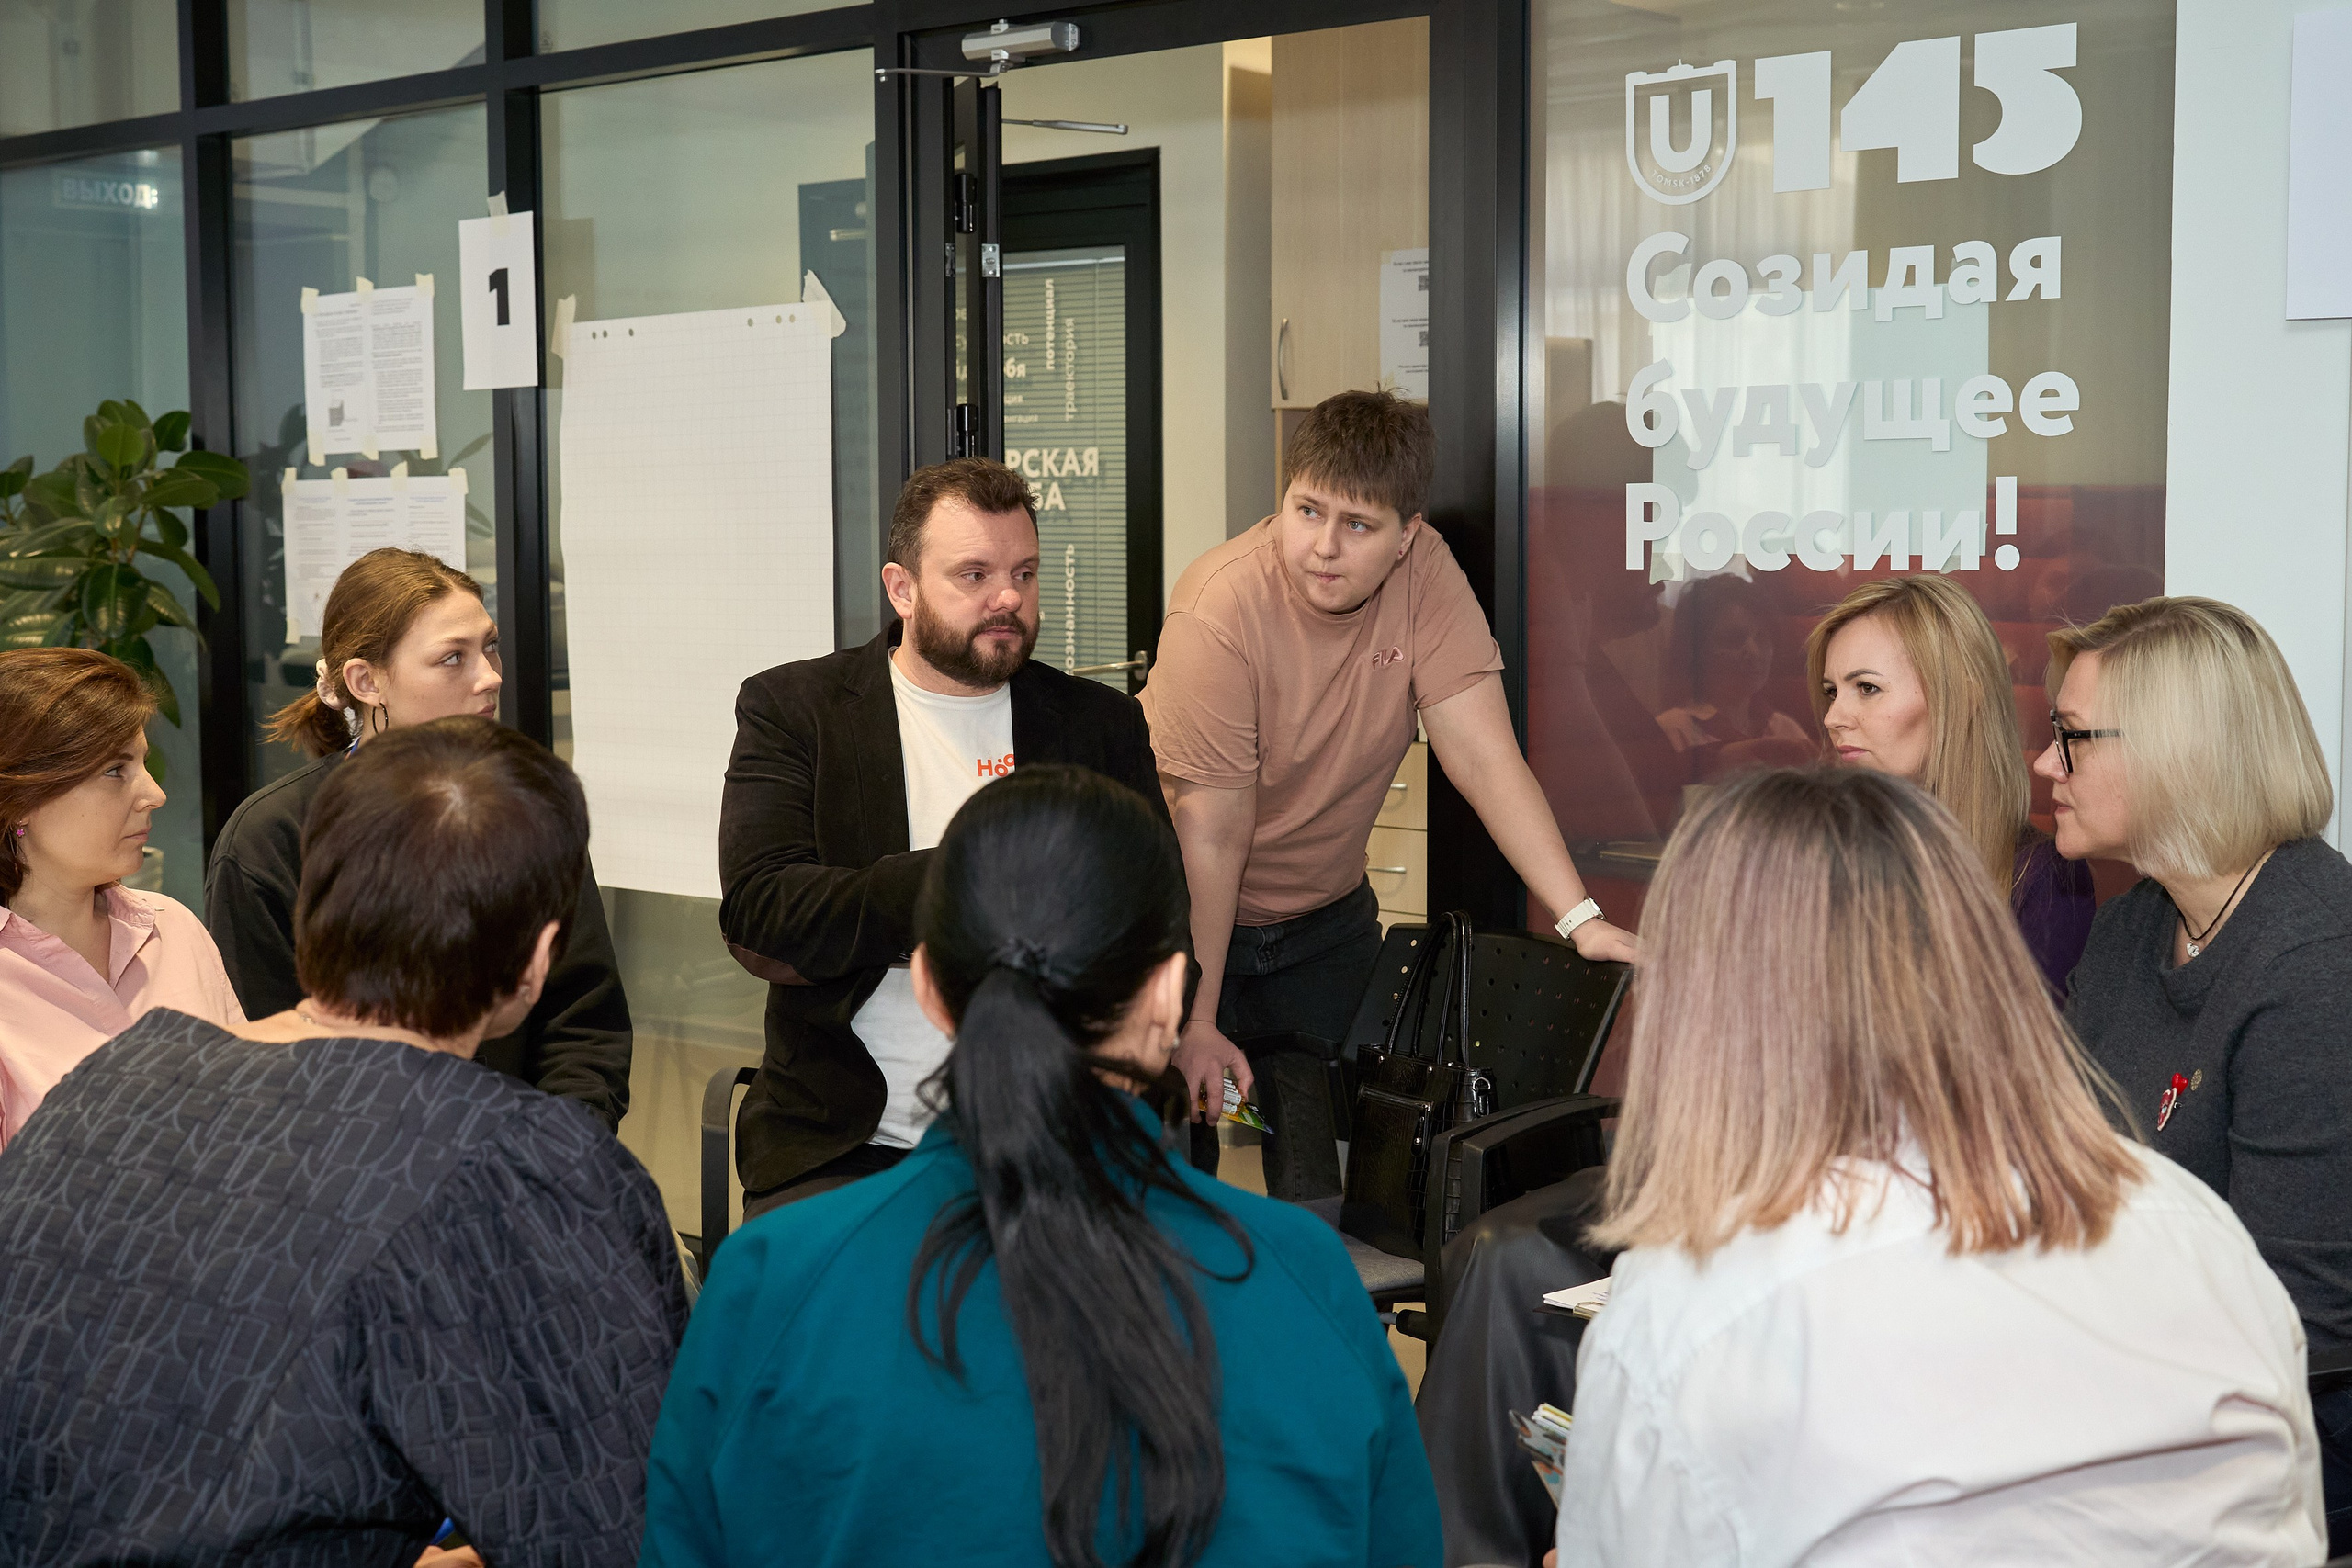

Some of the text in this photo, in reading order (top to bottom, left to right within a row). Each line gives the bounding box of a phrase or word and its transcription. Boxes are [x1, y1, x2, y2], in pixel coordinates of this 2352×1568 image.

[1755, 22, 2083, 193] 145
[1652, 164, 1712, 187] TOMSK-1878
[488, 267, 510, 326] 1
[1626, 231, 2062, 322] Созидая
[1004, 356, 1026, 378] бя
[1046, 278, 1056, 369] потенциал
[1065, 317, 1078, 423] траектория
[1625, 357, 2081, 470] будущее
[1625, 476, 2020, 572] России!
